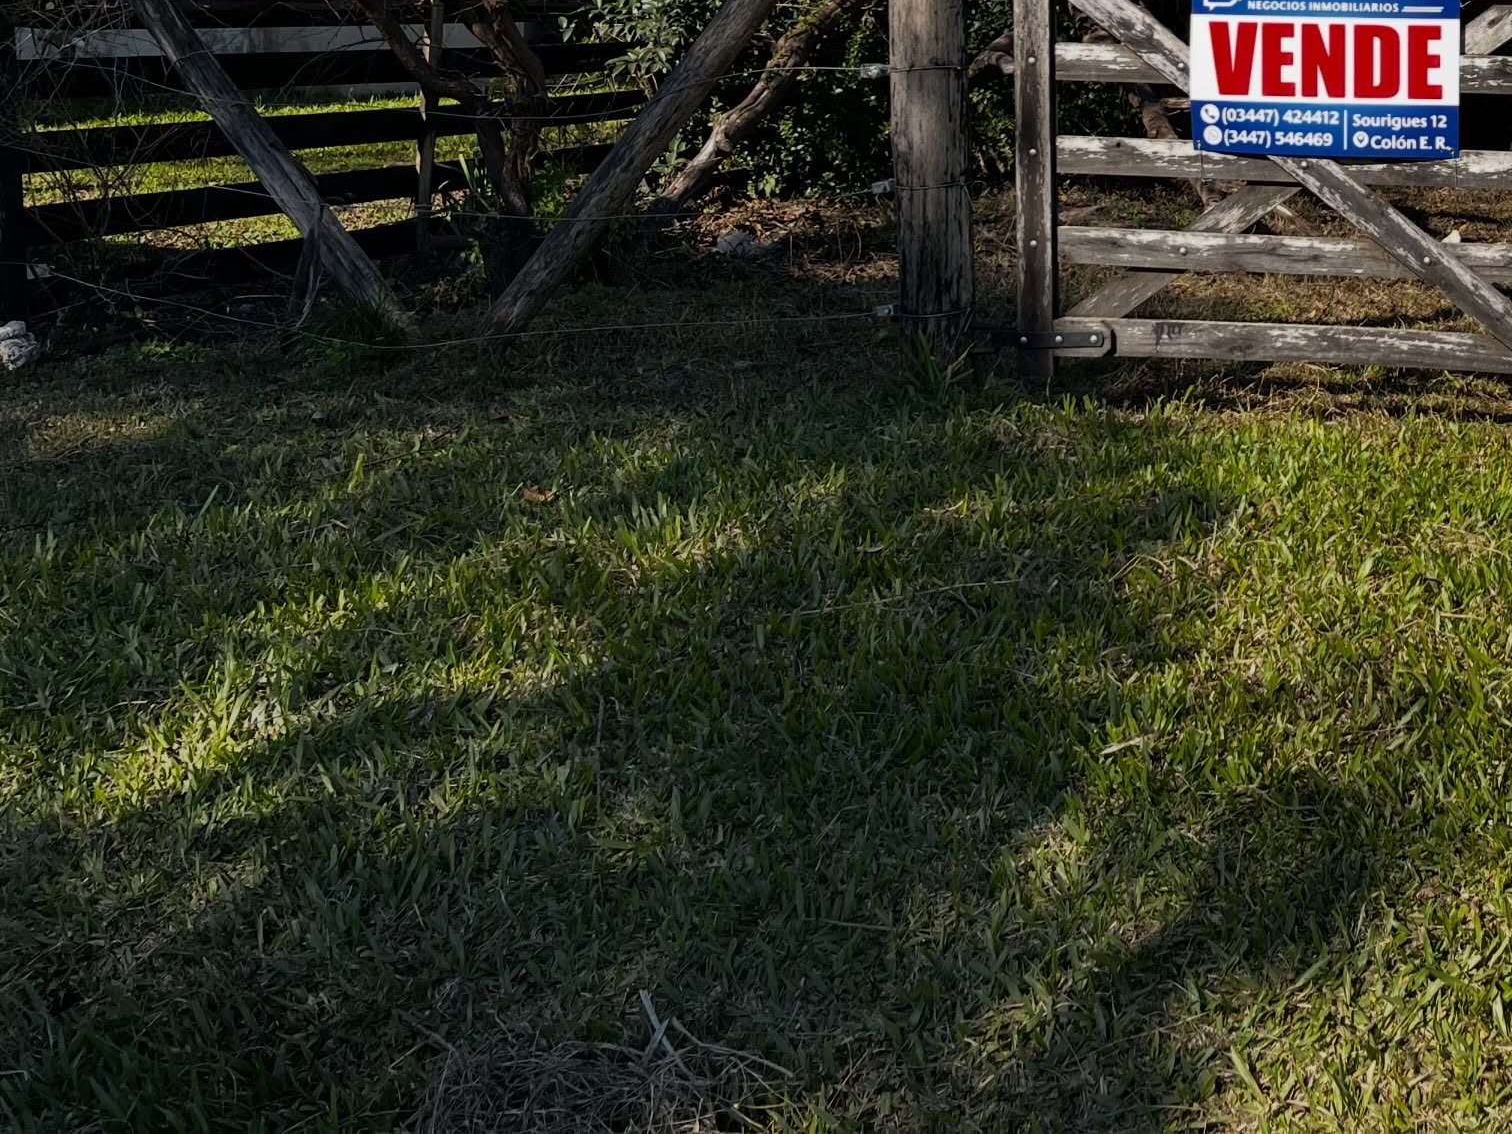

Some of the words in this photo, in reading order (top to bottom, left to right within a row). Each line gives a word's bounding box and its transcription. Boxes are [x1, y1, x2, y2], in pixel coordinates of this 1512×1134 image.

[1247, 0, 1306, 11] NEGOCIOS
[1309, 1, 1399, 13] INMOBILIARIOS
[1208, 21, 1443, 100] VENDE
[1221, 107, 1279, 127] (03447)
[1282, 109, 1340, 125] 424412
[1352, 113, 1427, 130] Sourigues
[1430, 115, 1448, 128] 12
[1223, 128, 1271, 148] (3447)
[1274, 130, 1333, 146] 546469
[1370, 134, 1417, 150] Colón
[1419, 136, 1433, 150] E.
